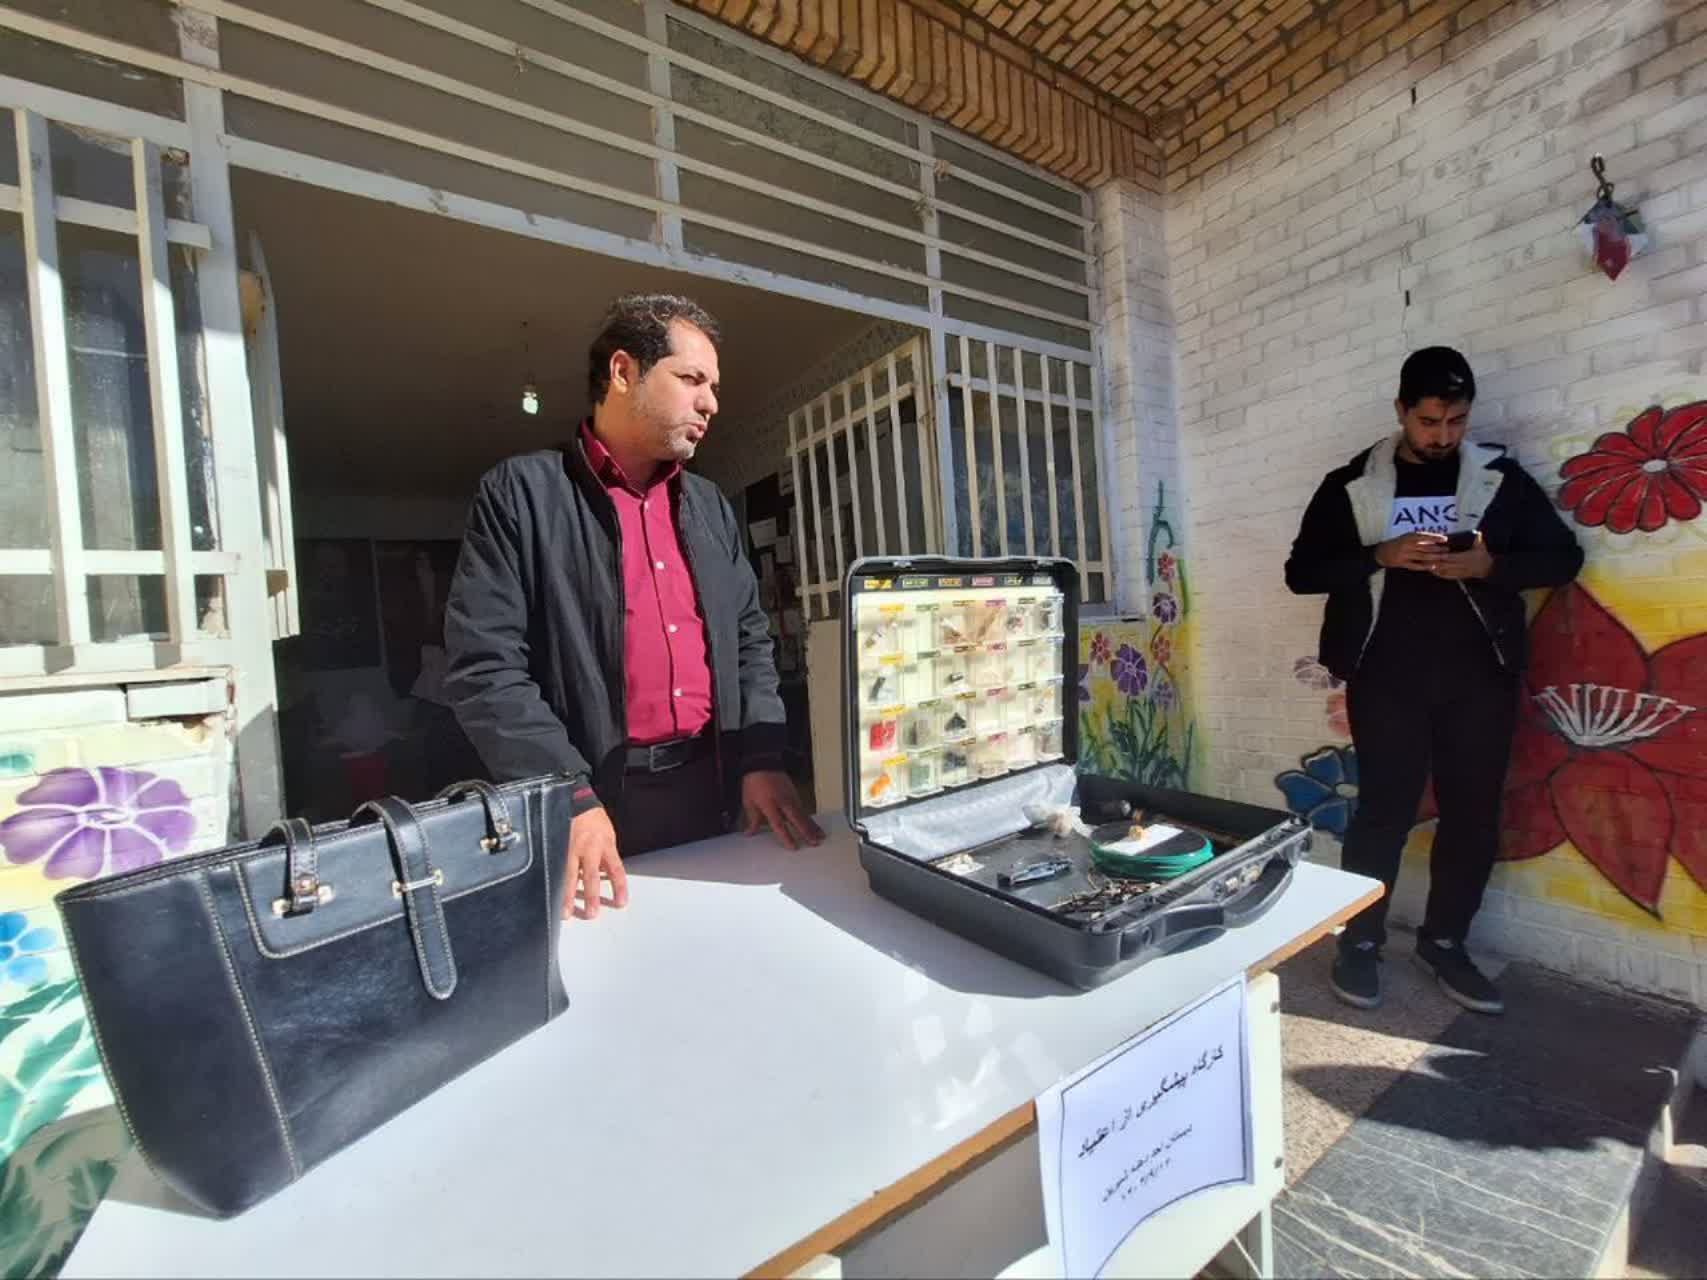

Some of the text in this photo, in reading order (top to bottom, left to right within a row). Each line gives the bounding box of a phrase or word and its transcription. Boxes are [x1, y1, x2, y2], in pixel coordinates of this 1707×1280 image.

[1078, 1044, 1223, 1158] کارگاه پیشگیری از اعتیاد
